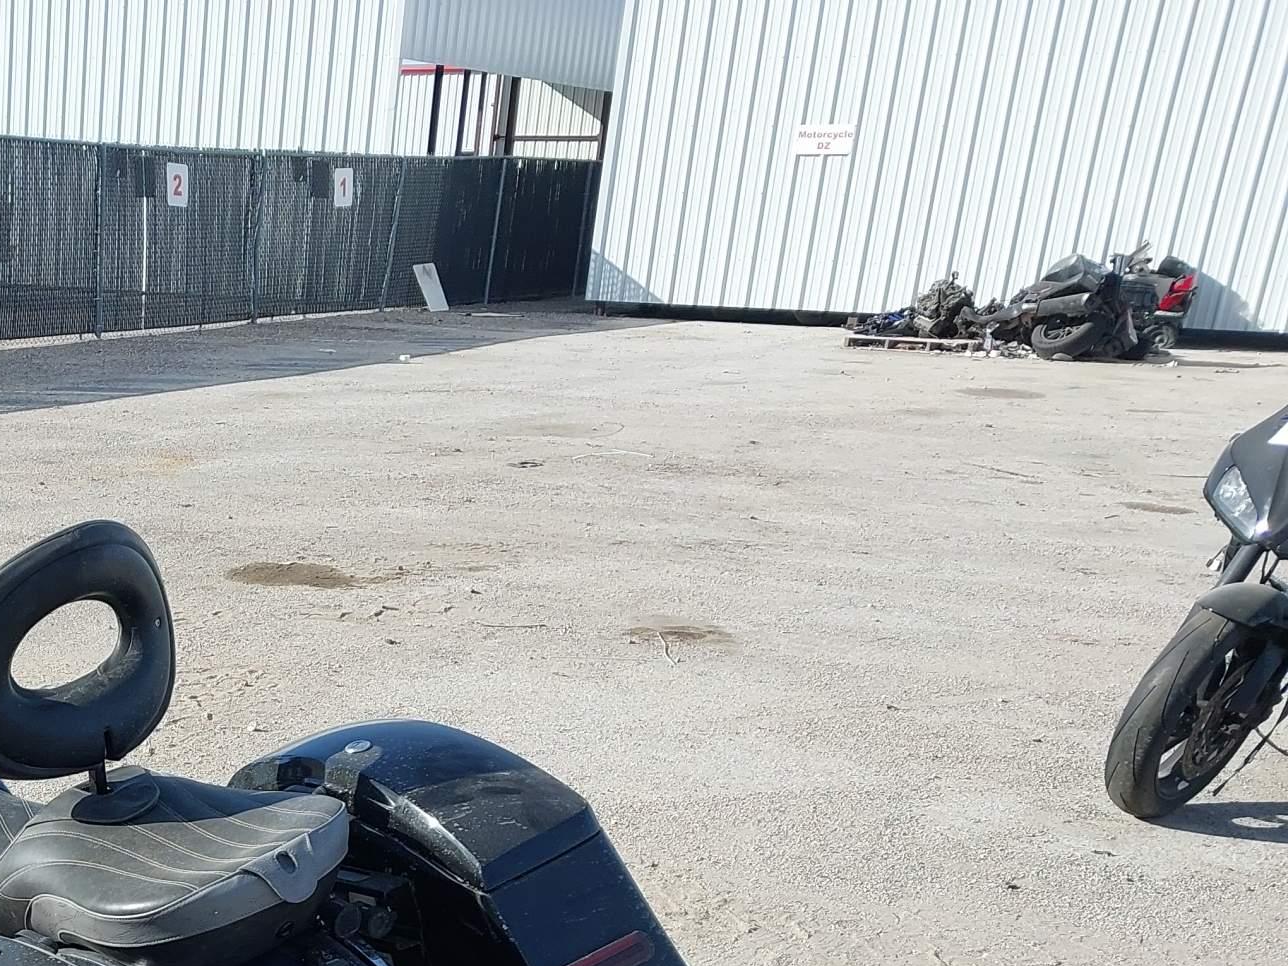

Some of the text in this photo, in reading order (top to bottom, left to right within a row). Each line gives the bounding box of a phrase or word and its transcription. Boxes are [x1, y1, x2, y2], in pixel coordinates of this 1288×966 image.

[798, 131, 854, 140] Motorcycle
[817, 142, 831, 150] DZ
[173, 174, 184, 196] 2
[339, 177, 347, 197] 1
